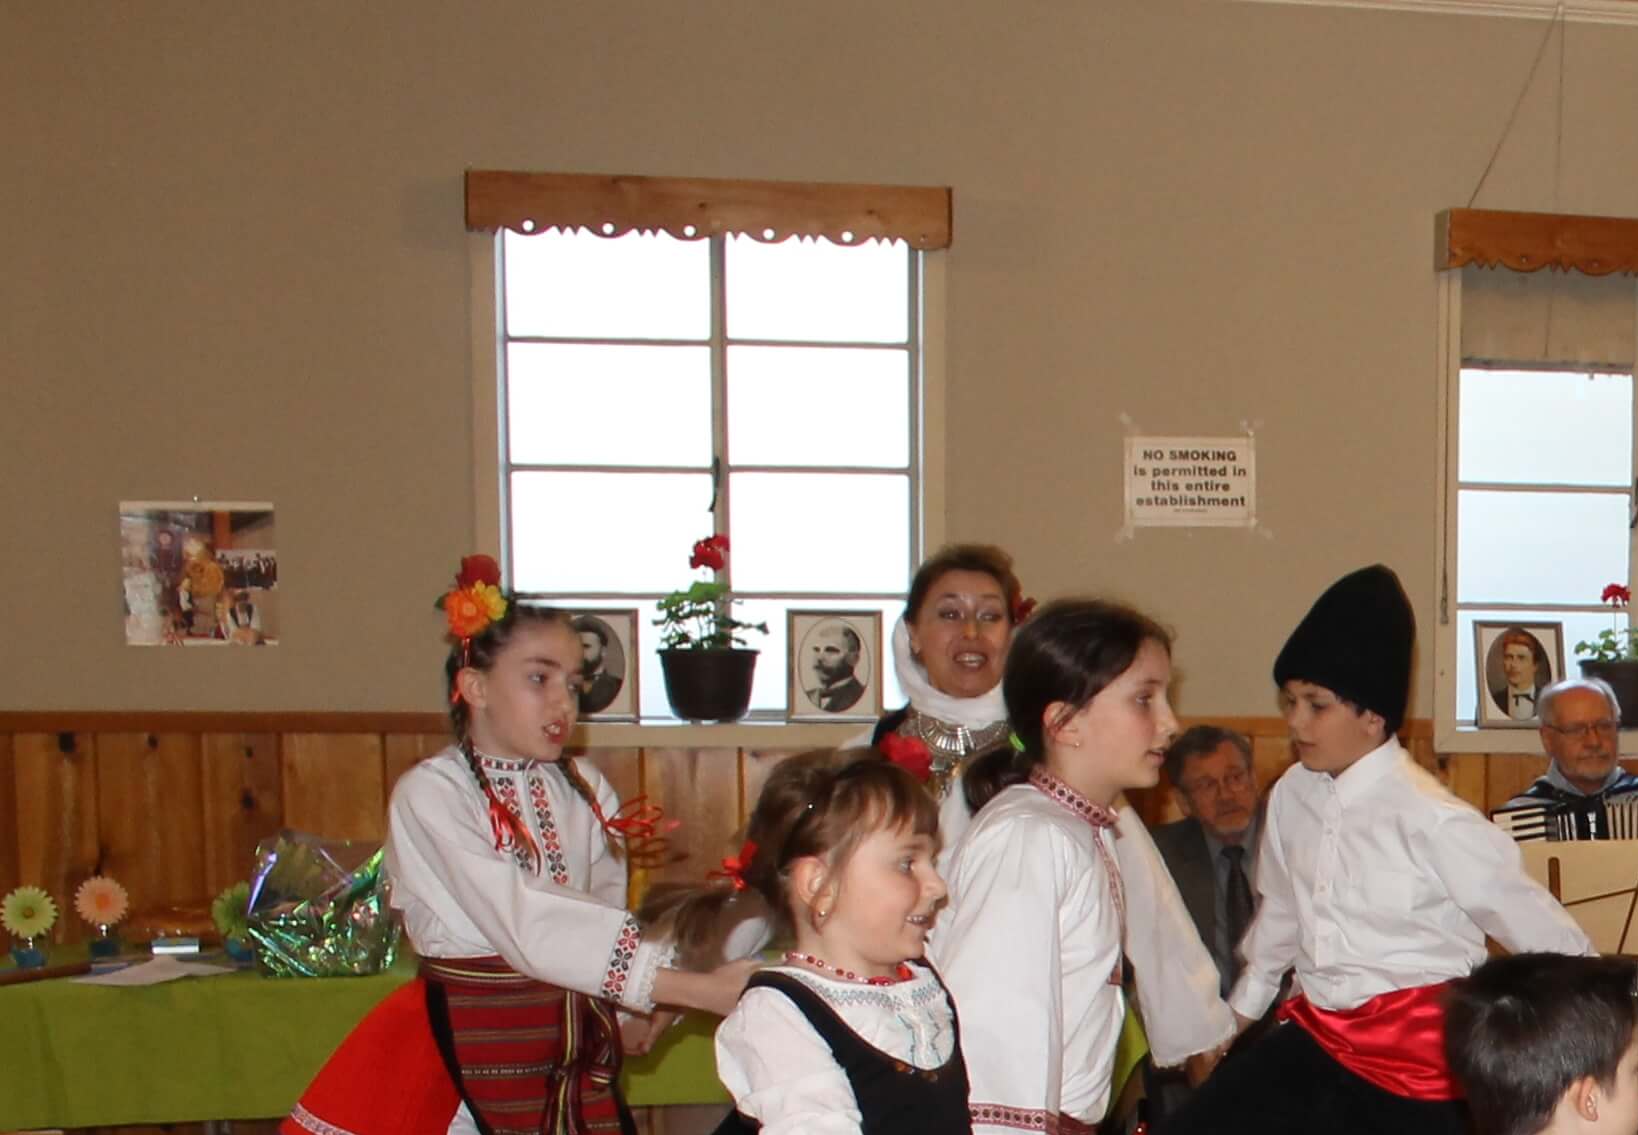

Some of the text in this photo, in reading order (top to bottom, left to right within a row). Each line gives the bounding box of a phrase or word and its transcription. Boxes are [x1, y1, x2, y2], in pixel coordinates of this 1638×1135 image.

[1142, 449, 1237, 462] NO SMOKING
[1133, 465, 1247, 478] is permitted in
[1151, 480, 1231, 491] this entire
[1136, 495, 1246, 507] establishment
